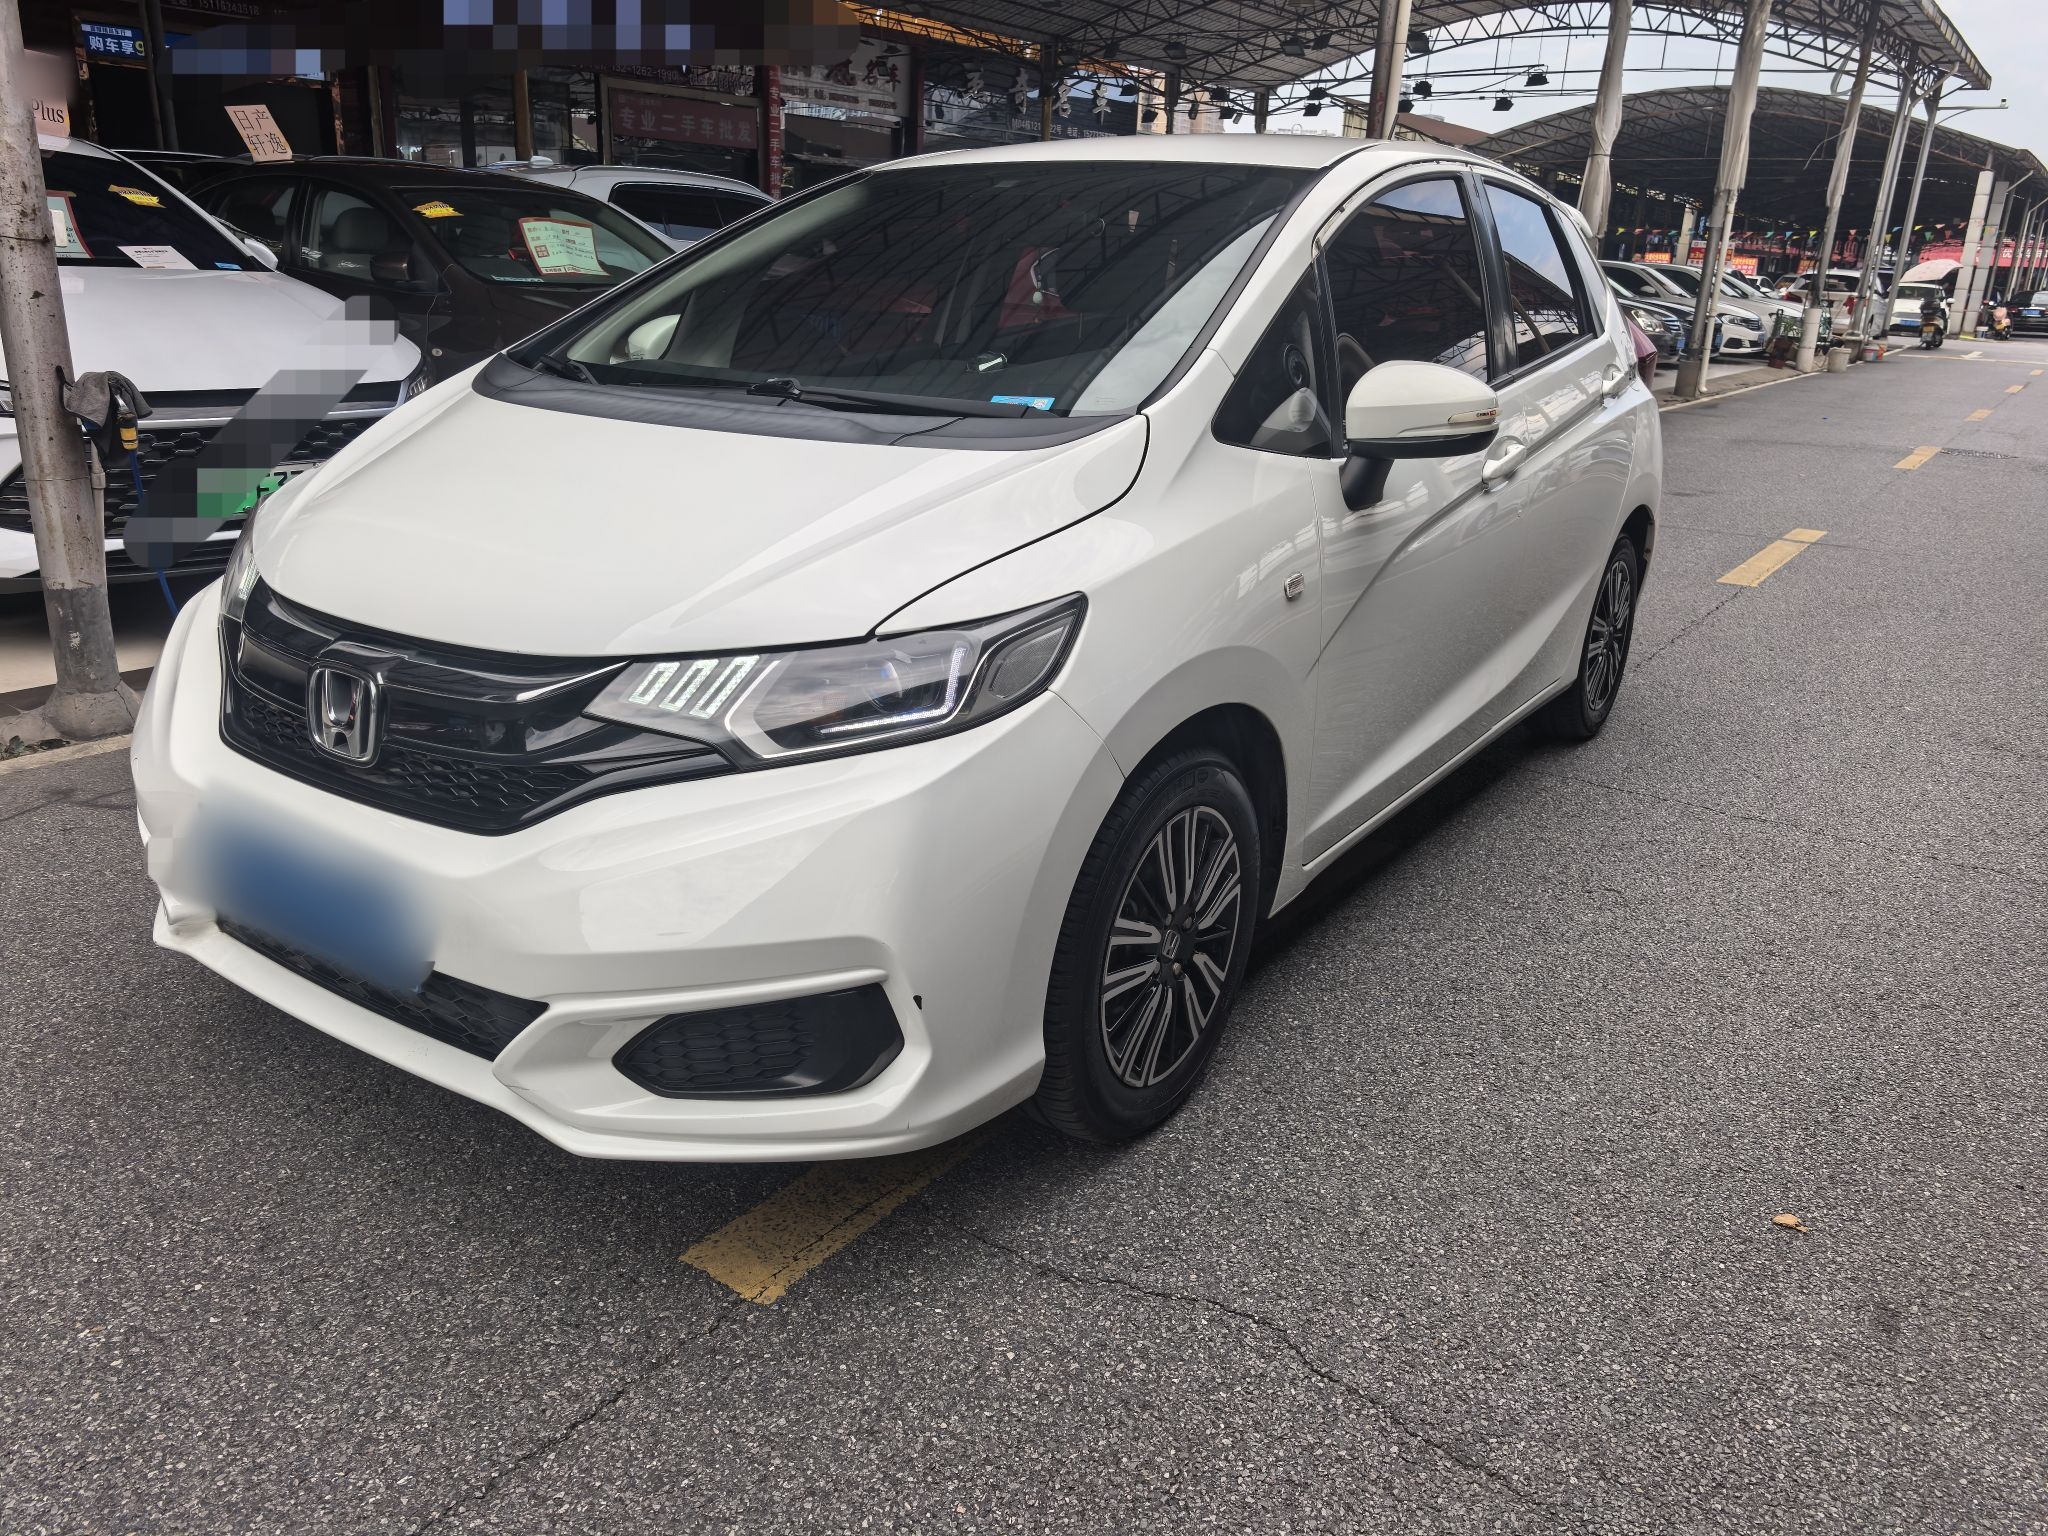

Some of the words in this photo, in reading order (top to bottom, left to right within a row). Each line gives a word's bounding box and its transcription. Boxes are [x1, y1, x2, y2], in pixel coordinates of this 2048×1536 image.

[233, 108, 269, 131] 日产
[619, 107, 753, 143] 专业二手车批发
[246, 132, 288, 156] 轩逸
